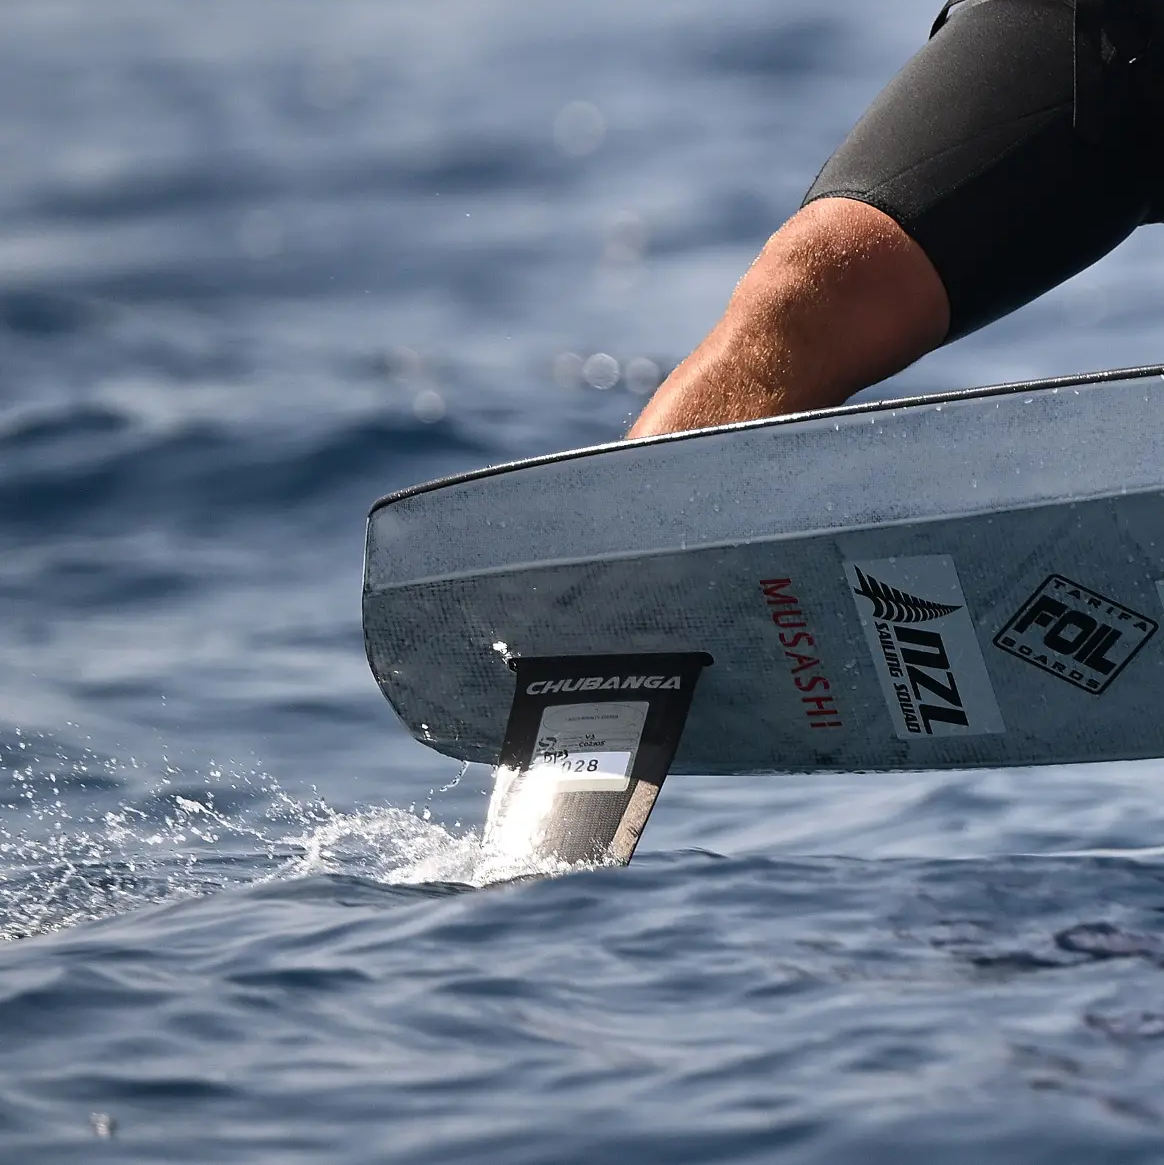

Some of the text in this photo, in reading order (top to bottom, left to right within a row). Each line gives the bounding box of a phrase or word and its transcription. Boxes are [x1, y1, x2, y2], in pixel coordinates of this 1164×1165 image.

[1013, 594, 1124, 676] FOIL
[1053, 579, 1148, 633] TARIFA
[526, 675, 681, 696] CHUBANGA
[759, 578, 843, 729] MUSASHI
[874, 621, 922, 734] SAILING SQUAD
[893, 625, 970, 735] NZL
[1000, 636, 1101, 689] BOARDS
